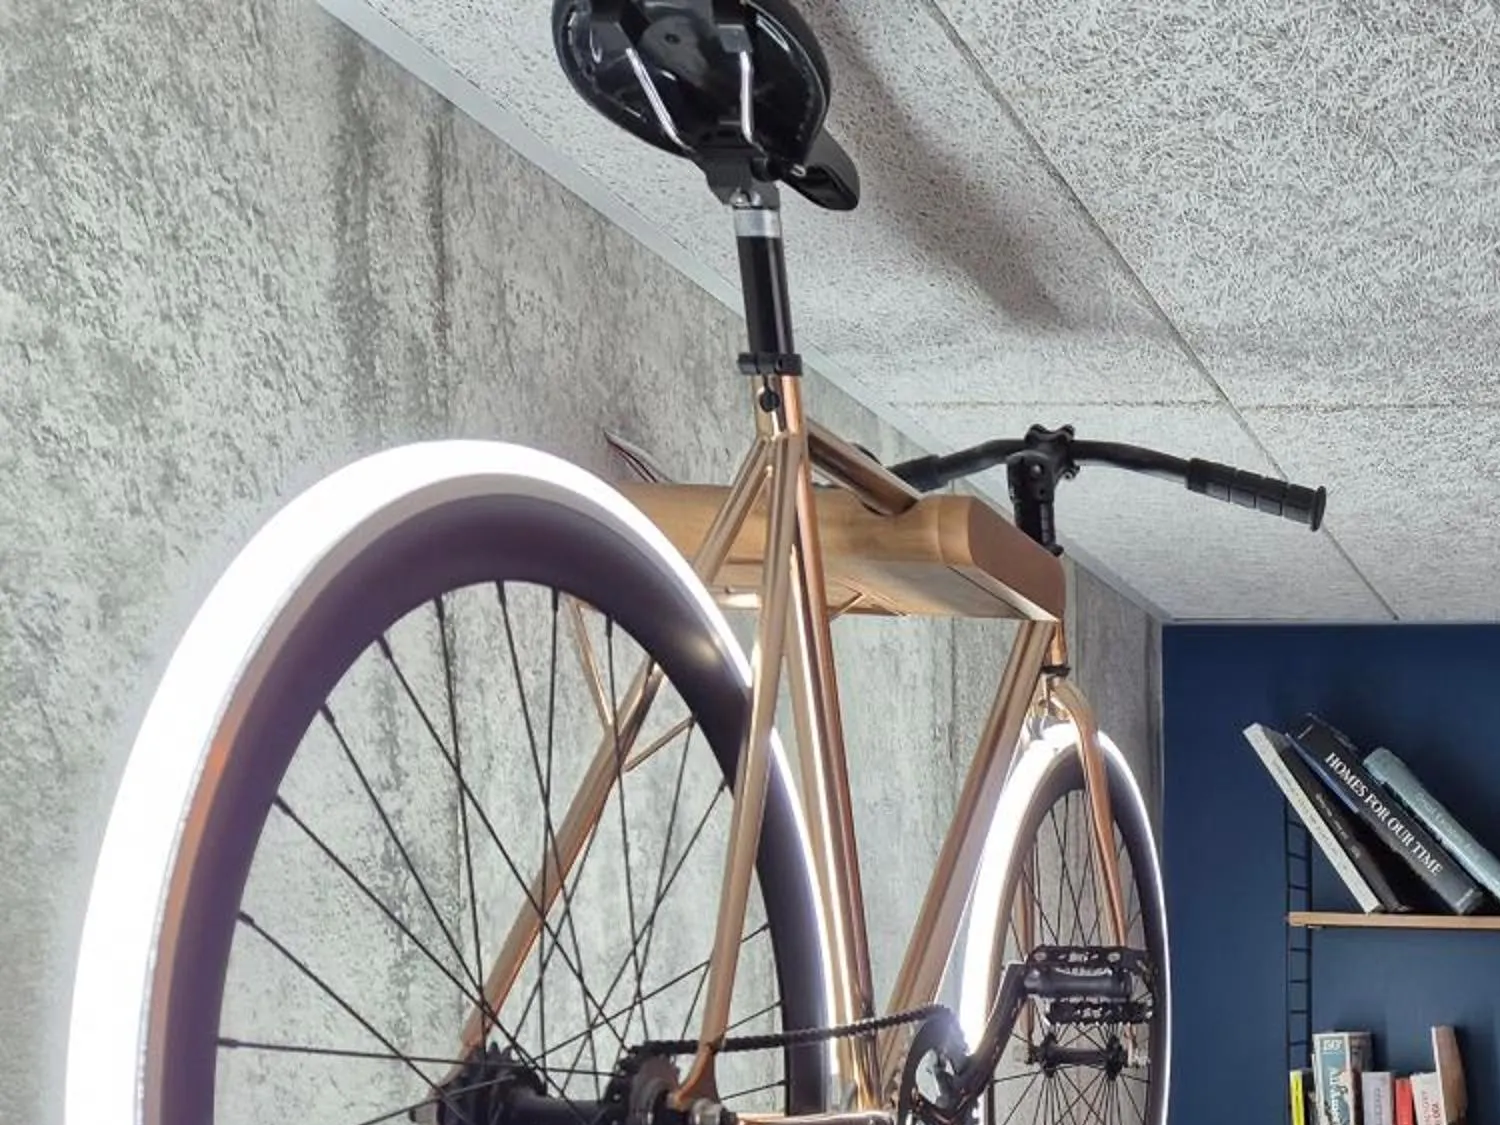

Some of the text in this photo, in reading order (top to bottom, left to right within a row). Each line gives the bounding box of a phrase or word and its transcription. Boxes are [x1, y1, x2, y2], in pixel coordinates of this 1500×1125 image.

[1325, 753, 1367, 797] HOMES
[1364, 792, 1388, 823] FOR
[1387, 817, 1414, 848] OUR
[1412, 842, 1443, 876] TIME
